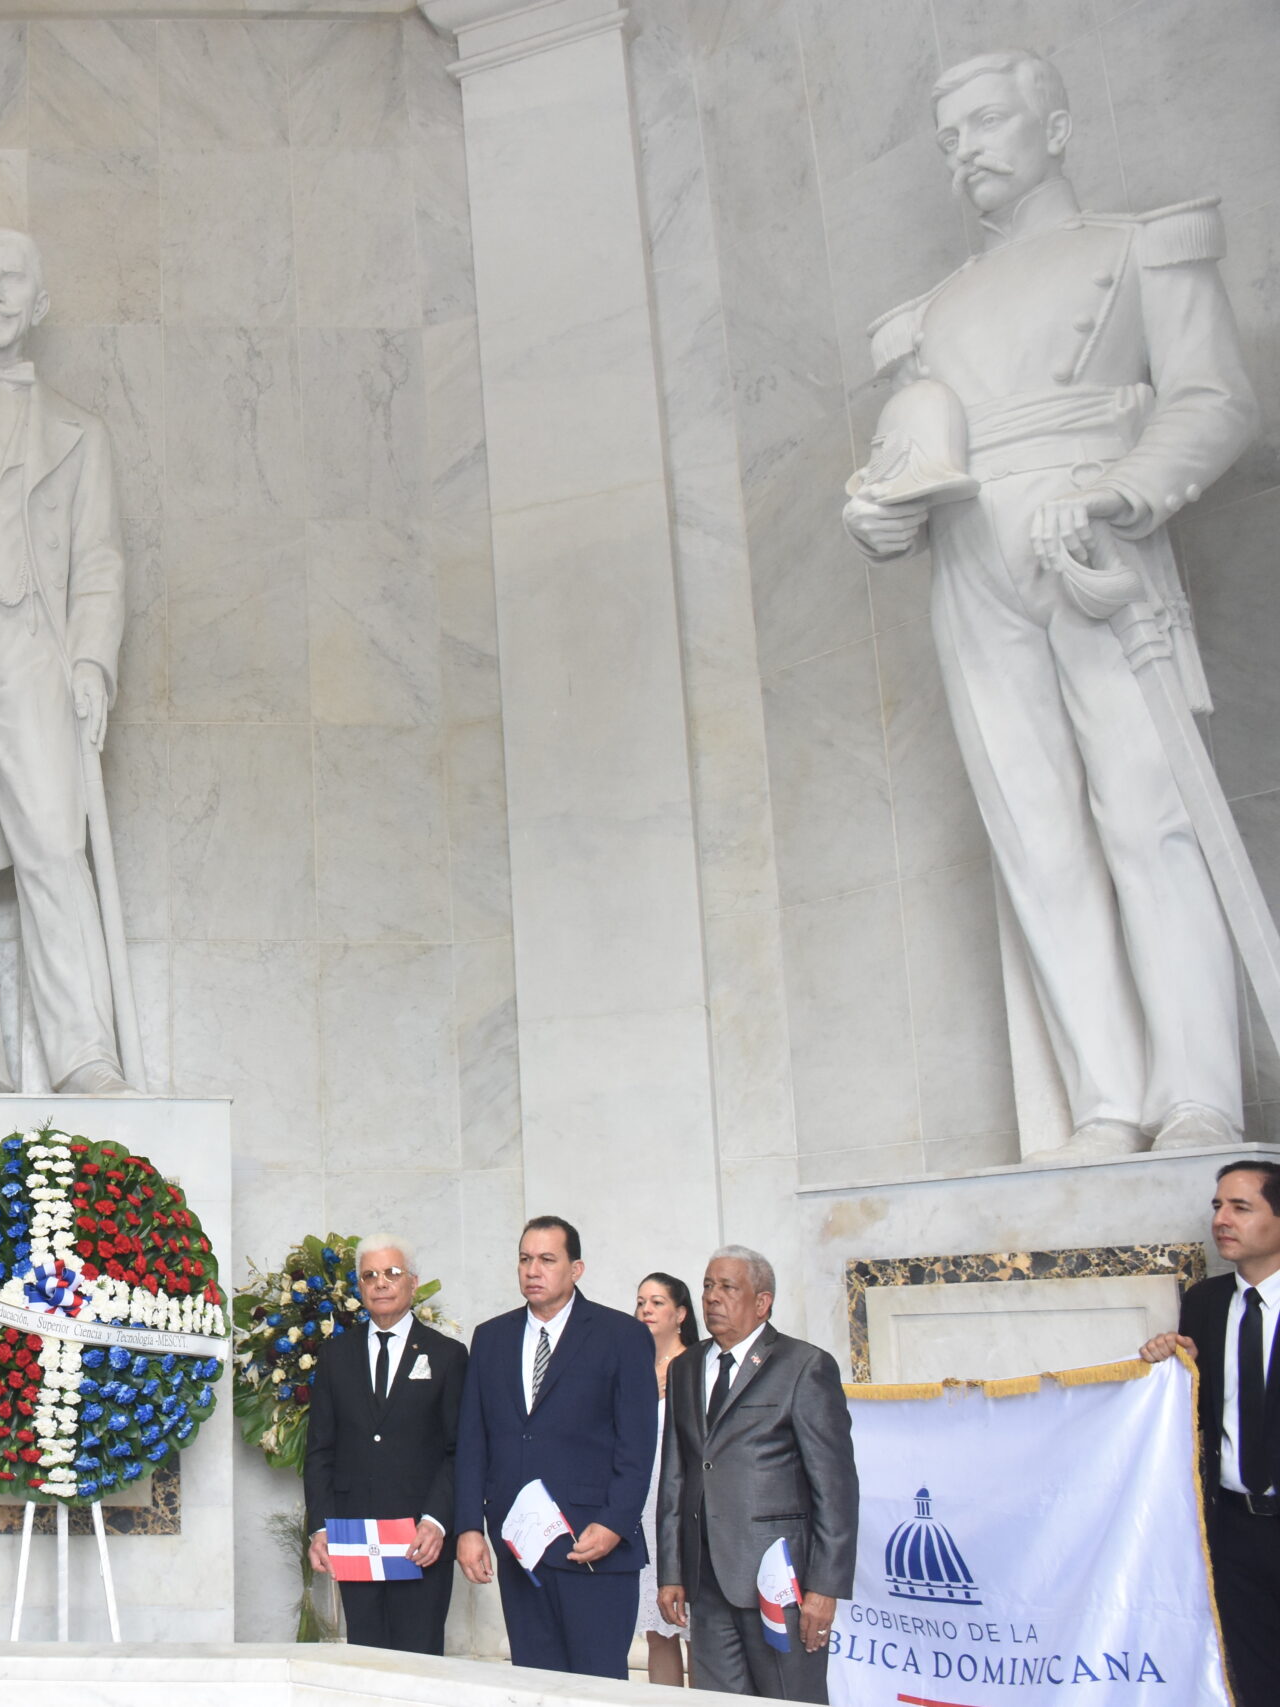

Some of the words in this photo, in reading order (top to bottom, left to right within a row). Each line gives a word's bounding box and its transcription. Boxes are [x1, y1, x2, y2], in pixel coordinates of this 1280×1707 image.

[36, 1316, 69, 1334] Superior
[74, 1324, 102, 1340] Ciencia
[106, 1332, 111, 1342] y
[850, 1604, 957, 1640] GOBIERNO
[968, 1622, 1001, 1642] DE
[1010, 1623, 1038, 1644] LA
[932, 1650, 1167, 1686] DOMINICANA
